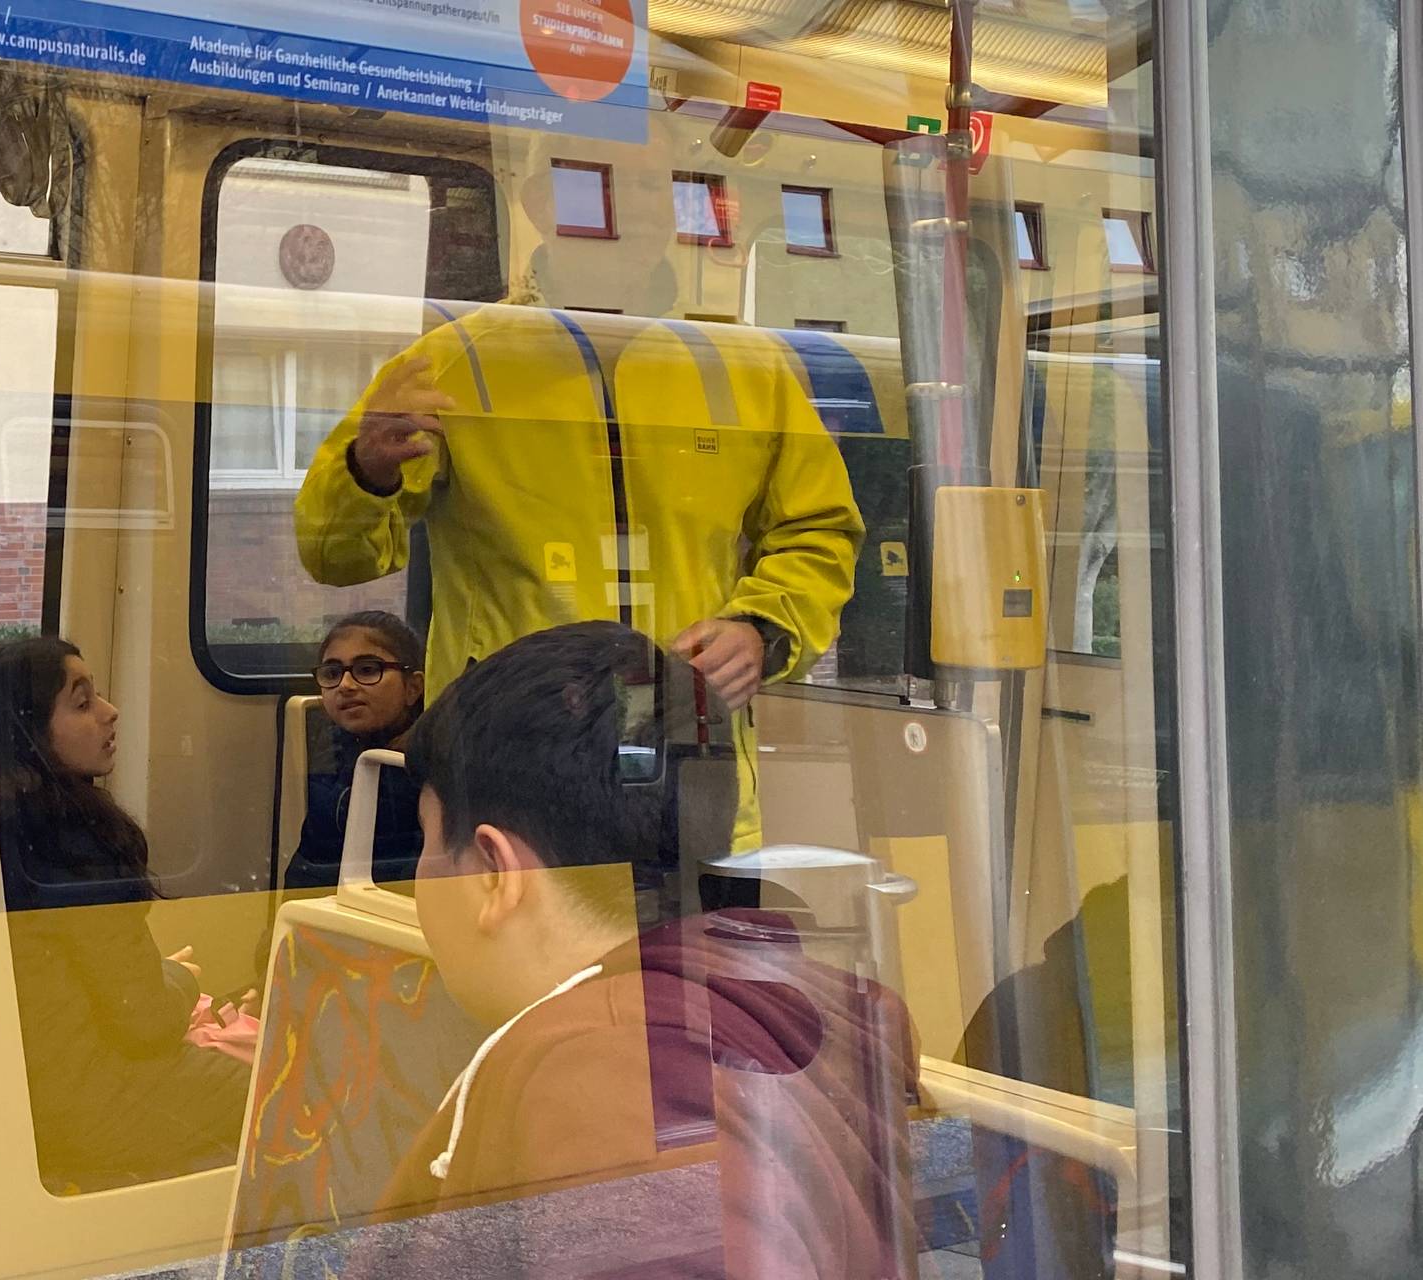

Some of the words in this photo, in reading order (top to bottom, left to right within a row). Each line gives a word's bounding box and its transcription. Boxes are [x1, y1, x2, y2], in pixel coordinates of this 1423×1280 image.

[532, 14, 624, 48] STUDIENPROGRAMM
[189, 36, 253, 59] Akademie
[255, 44, 272, 61] für
[276, 48, 356, 73] Ganzheitliche
[359, 60, 472, 93] Gesundheitsbildung
[189, 58, 274, 85] Ausbildungen
[278, 72, 301, 87] und
[304, 74, 360, 95] Seminare
[377, 84, 447, 107] Anerkannter
[449, 94, 563, 124] Weiterbildungsträger
